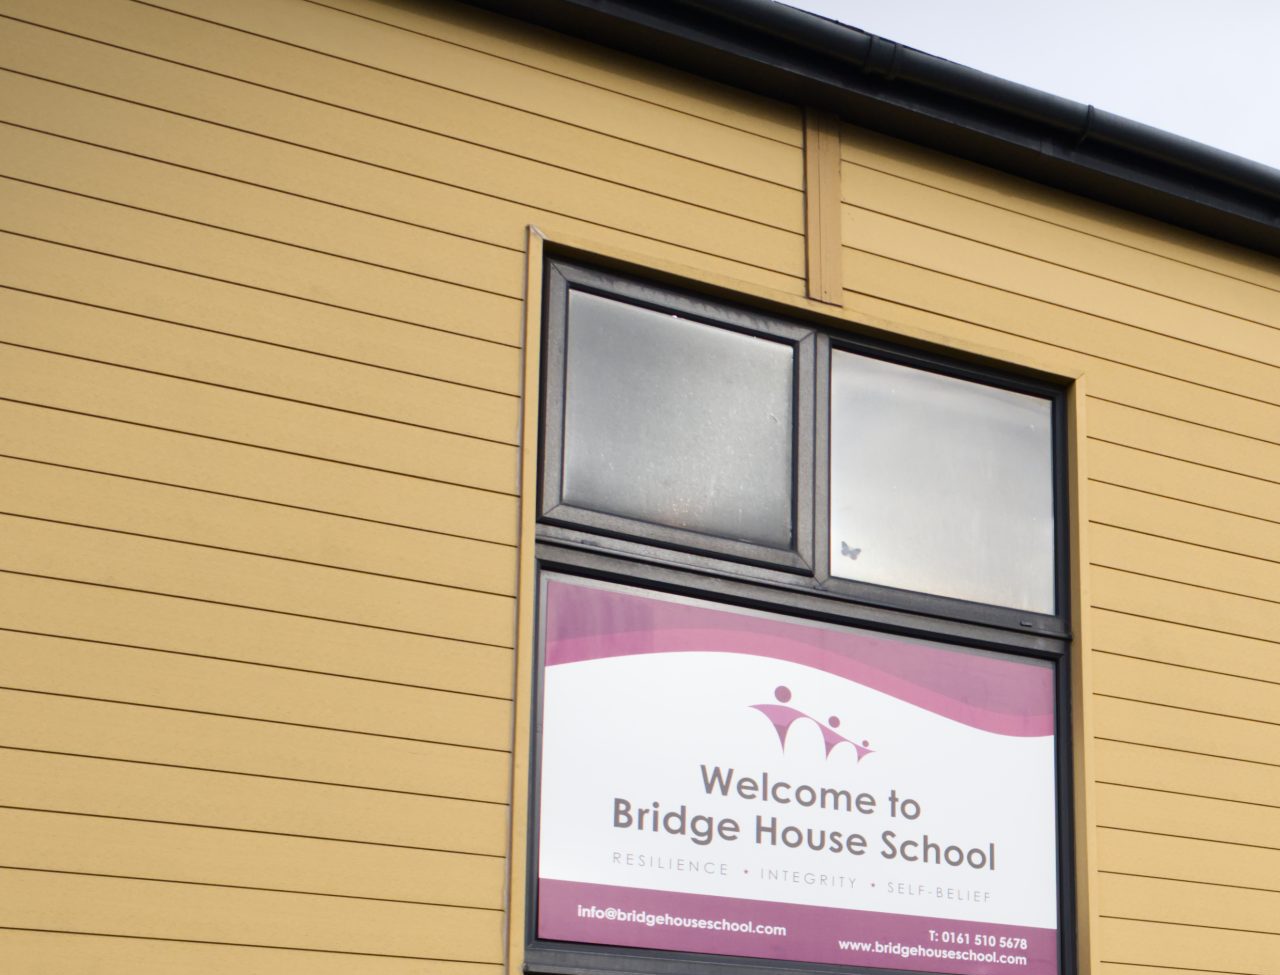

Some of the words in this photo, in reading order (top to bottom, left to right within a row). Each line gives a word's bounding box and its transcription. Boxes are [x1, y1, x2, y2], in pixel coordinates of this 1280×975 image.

[700, 764, 877, 815] Welcome
[888, 789, 922, 821] to
[612, 798, 740, 846] Bridge
[755, 815, 868, 857] House
[880, 829, 996, 872] School
[612, 851, 729, 877] RESILIENCE
[760, 867, 858, 890] INTEGRITY
[887, 881, 992, 904] SELF-BELIEF
[577, 904, 787, 937] info@bridgehouseschool.com
[928, 930, 940, 943] T:
[941, 930, 969, 946] 0161
[973, 932, 996, 948] 510
[999, 934, 1028, 951] 5678
[838, 939, 1027, 967] www.bridgehouseschool.com
